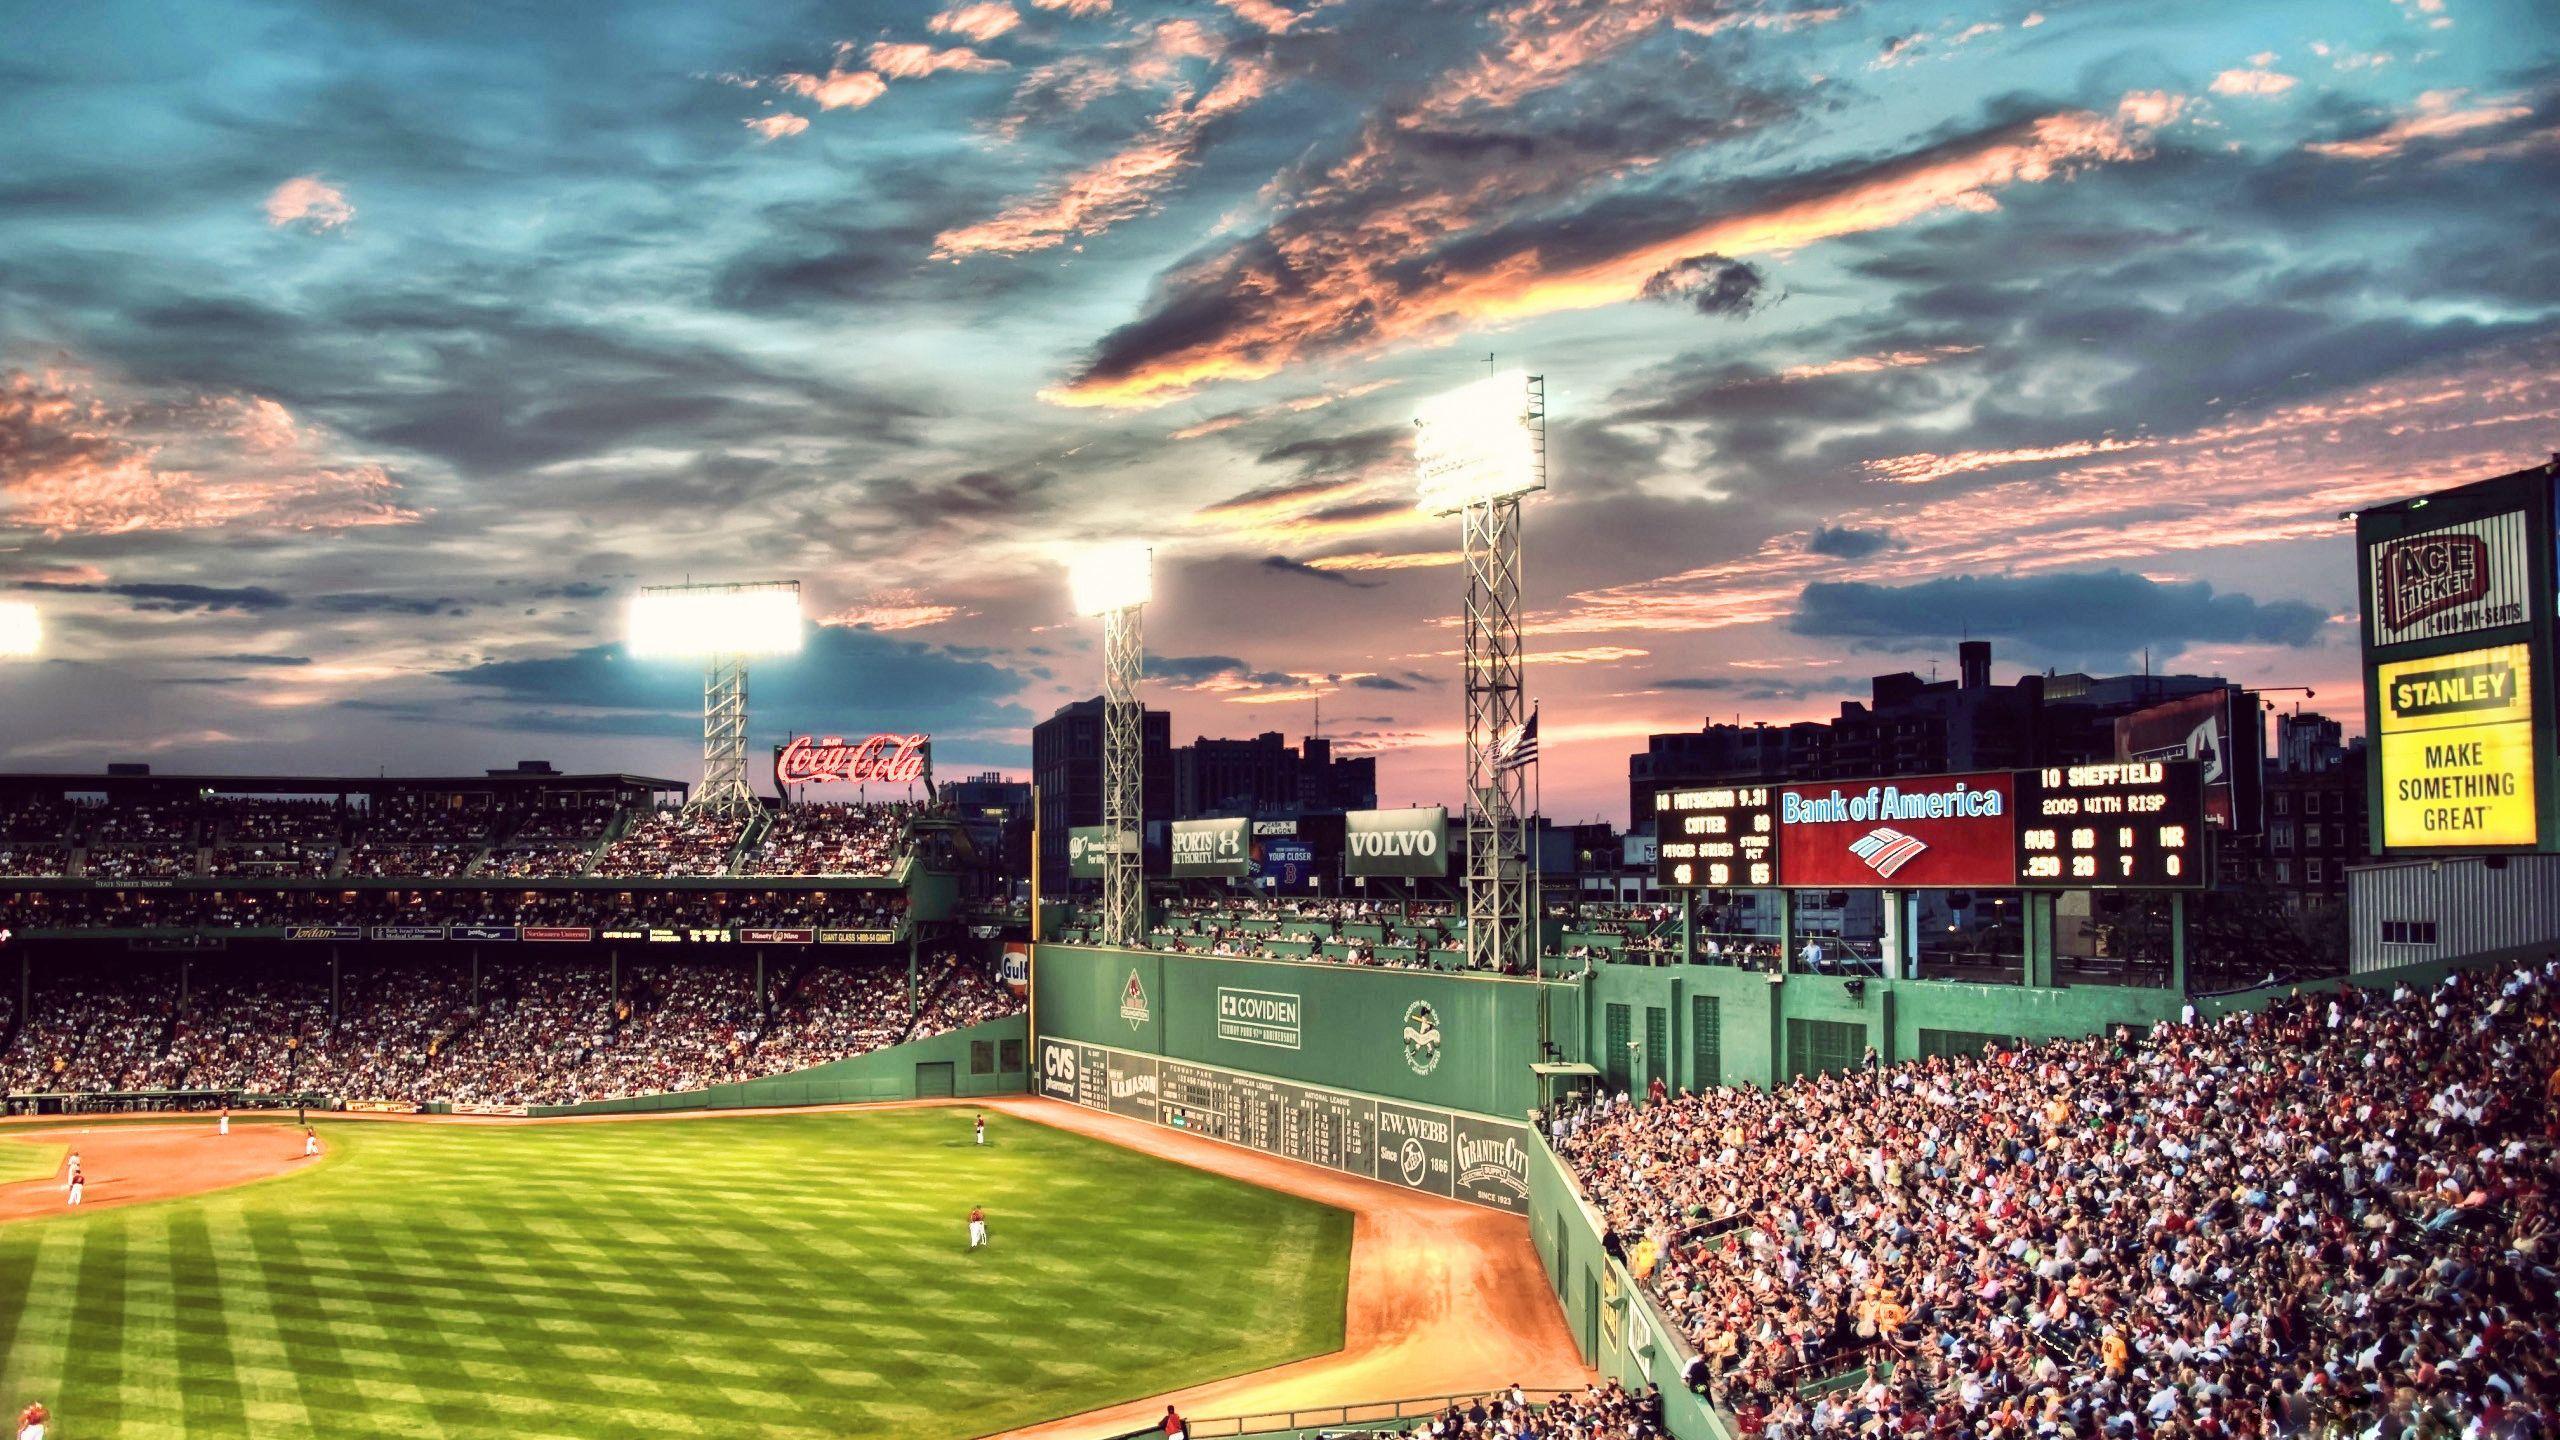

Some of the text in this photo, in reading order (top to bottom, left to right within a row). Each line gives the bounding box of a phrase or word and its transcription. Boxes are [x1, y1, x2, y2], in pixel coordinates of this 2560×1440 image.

[2399, 542, 2475, 584] ACE
[2400, 573, 2474, 617] TICKET
[2397, 672, 2506, 709] STANLEY
[777, 734, 930, 784] Coca-Cola
[2425, 742, 2483, 769] MAKE
[2041, 762, 2163, 788] 10 SHEFFIELD
[2399, 772, 2515, 801] SOMETHING
[1782, 783, 2002, 823] Bank of America
[2042, 794, 2166, 815] 2009 WITH RISP
[1685, 815, 1727, 834] CUTTER
[2424, 806, 2486, 831] GREAT
[1172, 831, 1213, 852] SPORTS
[1348, 829, 1437, 857] VOLVO
[2119, 827, 2132, 848] H
[2159, 826, 2185, 847] HR
[1173, 851, 1212, 864] AUTHORITY
[1268, 852, 1312, 861] YOUR CLOSER
[2022, 855, 2061, 877] .250
[2119, 855, 2133, 876] 7
[2166, 854, 2180, 876] 0
[751, 932, 799, 940] Ninety Nine
[822, 933, 838, 942] GIANT
[838, 933, 856, 942] GLASS
[1238, 997, 1296, 1023] COVIDIEN
[1045, 1045, 1075, 1080] CVS
[1170, 1064, 1193, 1075] FENWAY
[1045, 1076, 1076, 1098] pharmacy
[1232, 1077, 1255, 1088] AMERICAN
[1304, 1091, 1350, 1107] NATIONAL LEAGUE
[1380, 1111, 1449, 1144] F.W. WEBB
[1380, 1146, 1398, 1162] Since
[1430, 1157, 1449, 1174] 1866
[1484, 1166, 1507, 1178] SUPPLY
[1477, 1190, 1512, 1206] SINCE 1923
